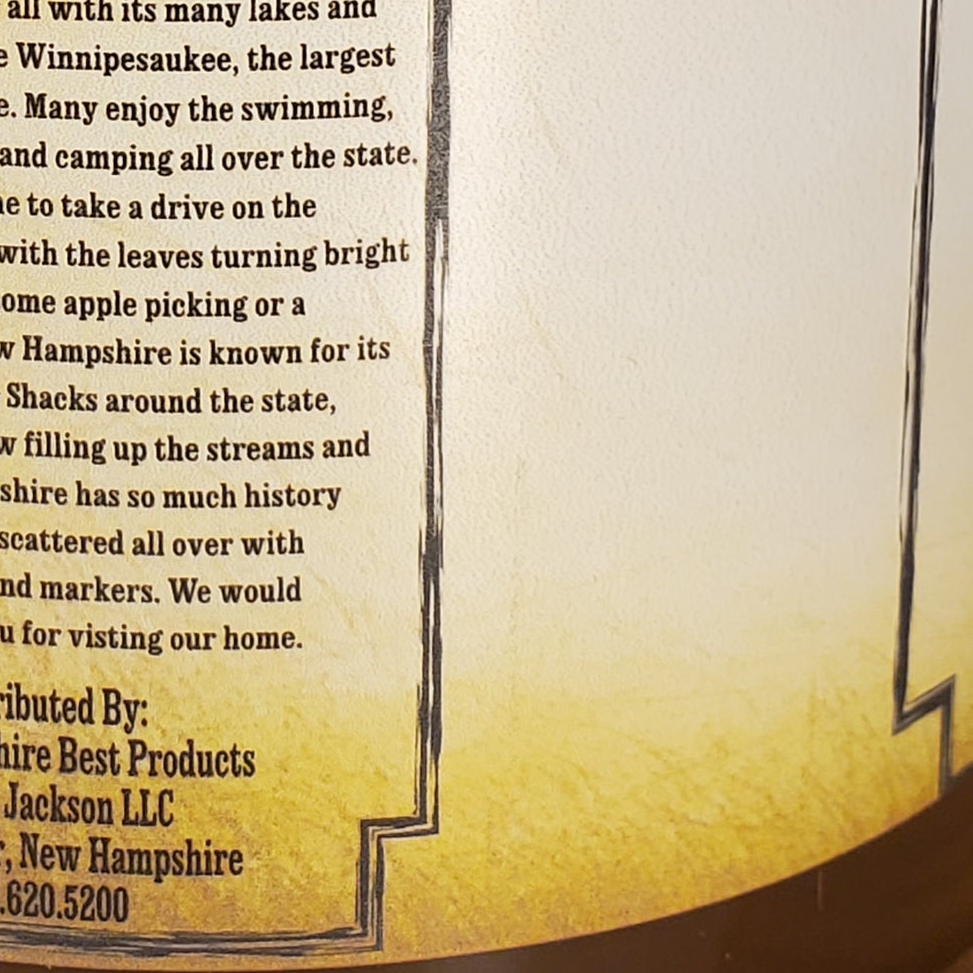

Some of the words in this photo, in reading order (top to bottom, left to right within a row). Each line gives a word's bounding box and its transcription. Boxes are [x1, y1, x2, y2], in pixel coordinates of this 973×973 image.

[165, 3, 241, 28] many
[16, 42, 239, 76] Winnipesaukee,
[247, 44, 292, 71] the
[300, 43, 396, 74] largest
[25, 92, 98, 126] Many
[106, 95, 180, 127] enjoy
[241, 92, 393, 123] swimming,
[0, 141, 48, 168] and
[55, 144, 173, 177] camping
[180, 144, 214, 171] all
[222, 151, 284, 171] over
[291, 142, 335, 169] the
[343, 142, 417, 167] state.
[61, 192, 120, 219] take
[151, 193, 224, 220] drive
[65, 240, 110, 267] the
[118, 241, 203, 269] leaves
[211, 242, 317, 272] turning
[324, 237, 409, 269] bright
[64, 290, 137, 321] apple
[145, 291, 248, 323] picking
[22, 335, 172, 369] Hampshire
[209, 339, 302, 365] known
[311, 337, 350, 363] for
[358, 335, 390, 360] its
[7, 382, 97, 412] Shacks
[106, 387, 202, 414] around
[210, 387, 254, 413] the
[261, 389, 336, 414] state,
[24, 431, 106, 465] filling
[154, 435, 199, 462] the
[207, 438, 314, 462] streams
[76, 480, 120, 507] has
[163, 483, 237, 508] much
[245, 482, 341, 511] history
[132, 530, 164, 556] all
[173, 538, 233, 556] over
[241, 529, 304, 555] with
[40, 576, 160, 603] markers.
[219, 576, 301, 603] would
[22, 620, 61, 646] for
[68, 623, 163, 656] visting
[170, 633, 217, 651] our
[224, 625, 302, 650] home.
[102, 688, 147, 734] By:
[58, 736, 121, 776] Best
[128, 739, 255, 778] Products
[4, 782, 114, 825] Jackson
[121, 788, 174, 827] LLC
[19, 832, 81, 871] New
[89, 837, 243, 883] Hampshire
